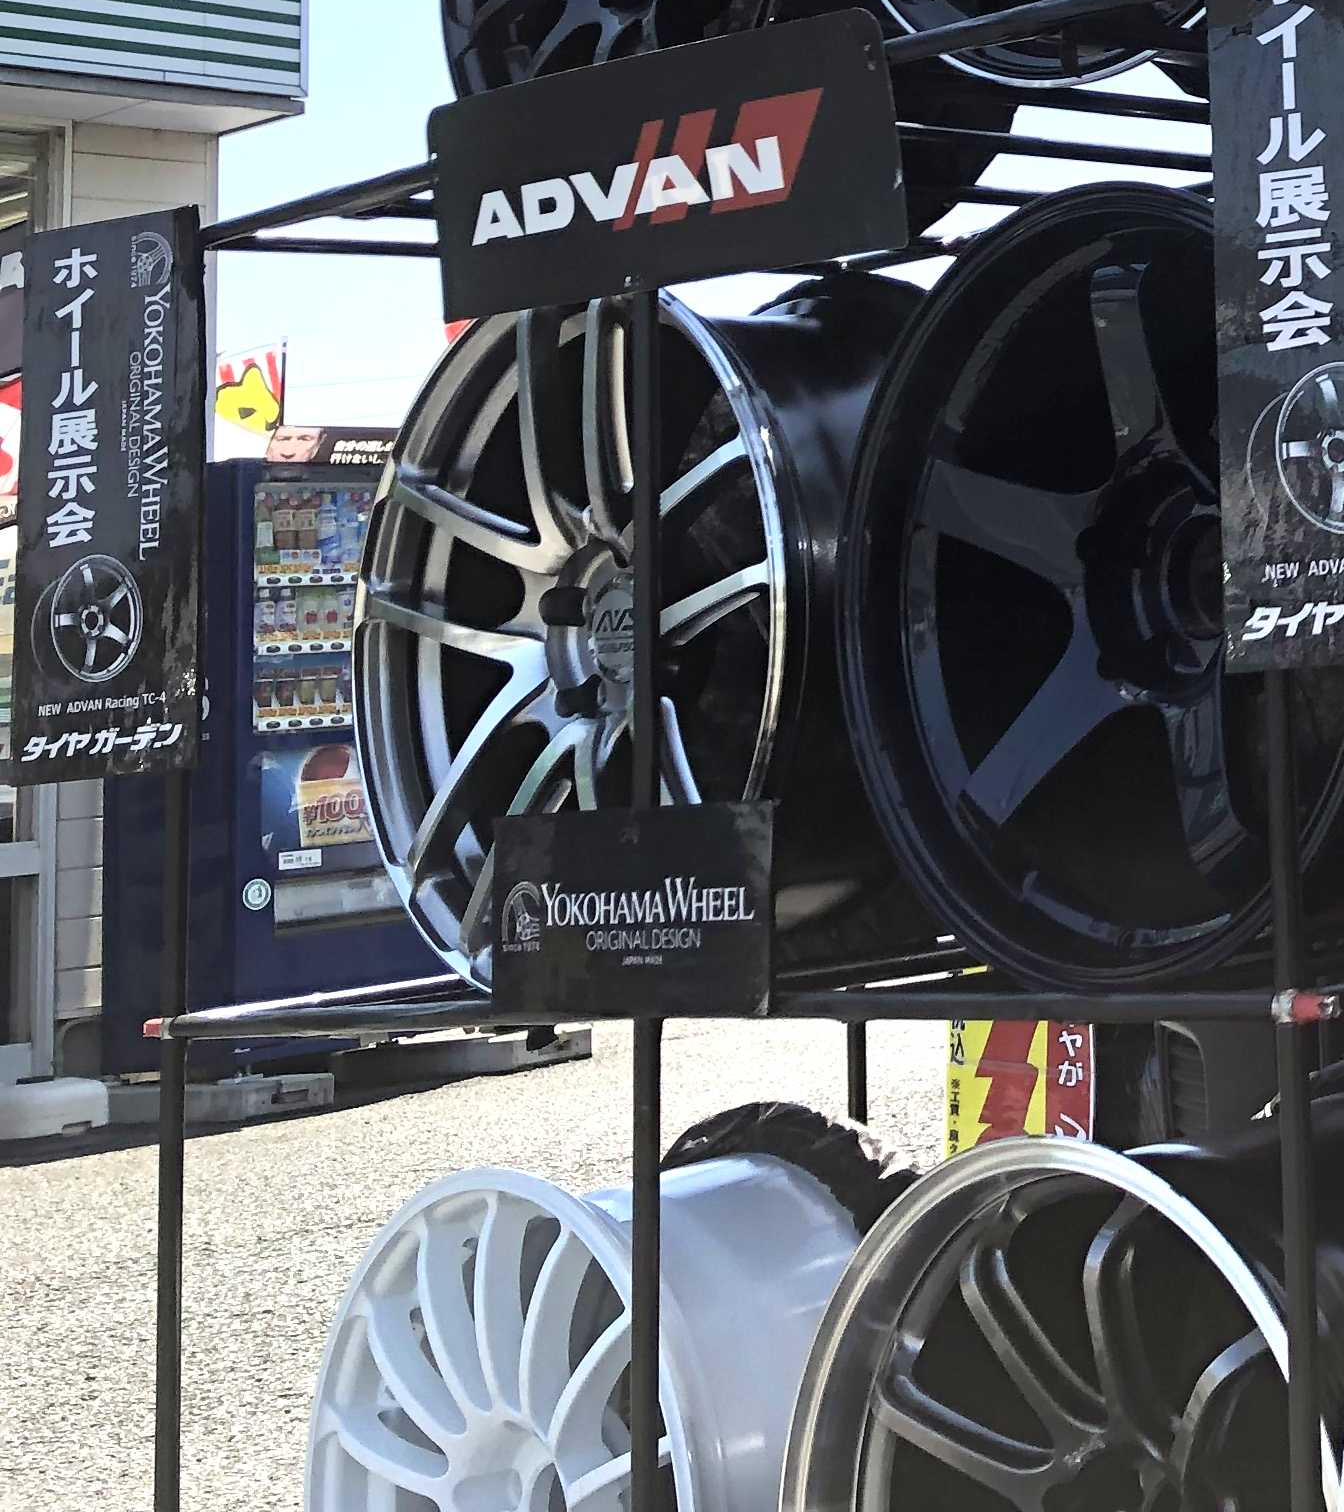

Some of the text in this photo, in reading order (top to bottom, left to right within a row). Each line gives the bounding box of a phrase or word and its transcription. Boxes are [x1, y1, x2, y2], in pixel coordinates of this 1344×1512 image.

[471, 134, 785, 246] ADVAN
[46, 248, 99, 548] ホイール展示会
[127, 352, 142, 498] ORIGINAL DESIGN
[1264, 561, 1299, 581] NEW
[38, 691, 166, 717] NEW ADVAN Racing TC-4
[21, 718, 183, 763] タイヤガーデン
[586, 928, 702, 951] ORIGINAL DESIGN
